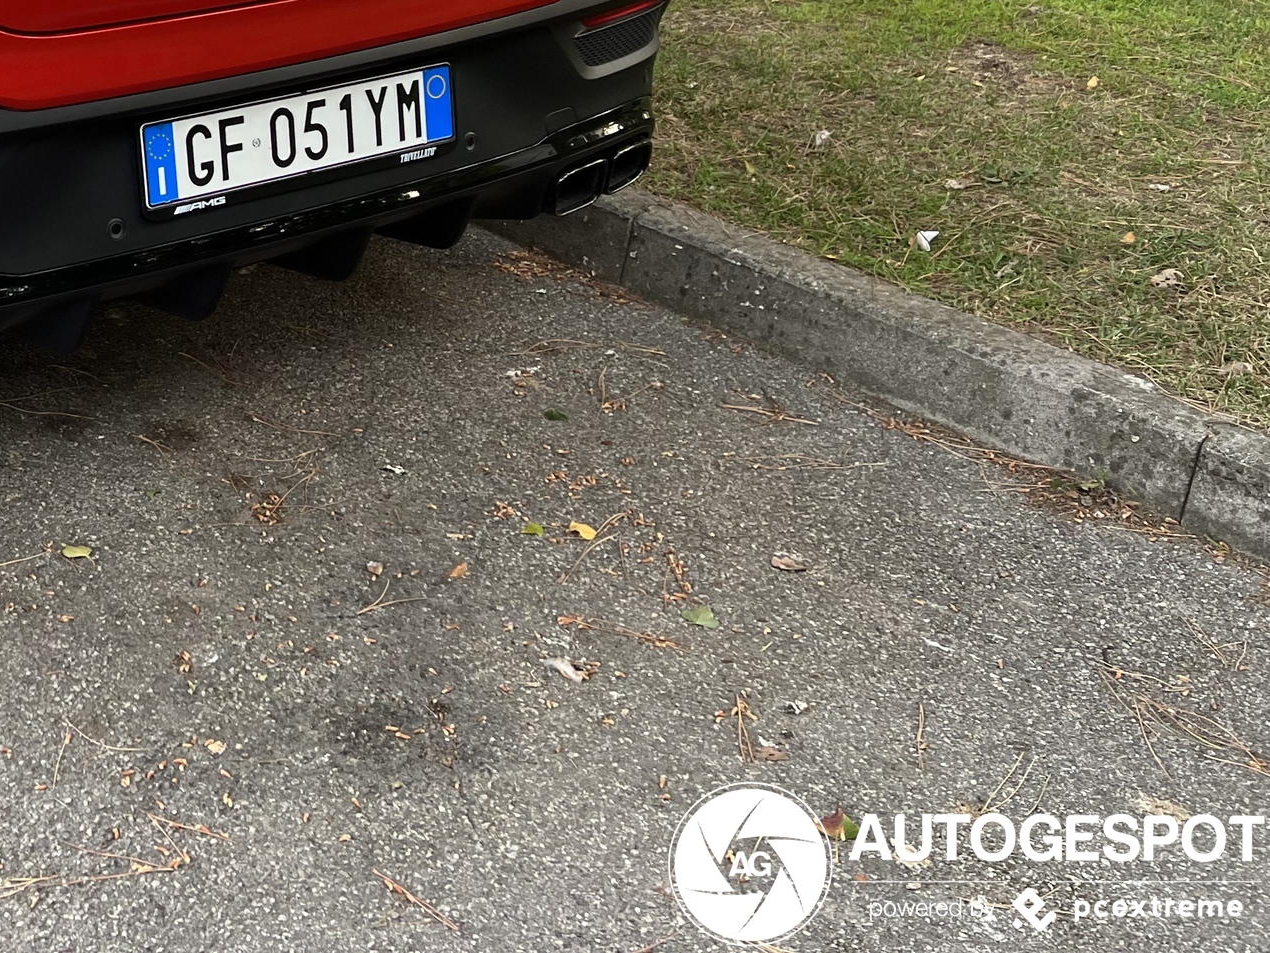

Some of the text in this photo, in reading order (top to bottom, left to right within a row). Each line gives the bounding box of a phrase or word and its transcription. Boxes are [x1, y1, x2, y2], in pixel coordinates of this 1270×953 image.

[185, 79, 423, 187] GF 051YM
[191, 196, 226, 211] AMG
